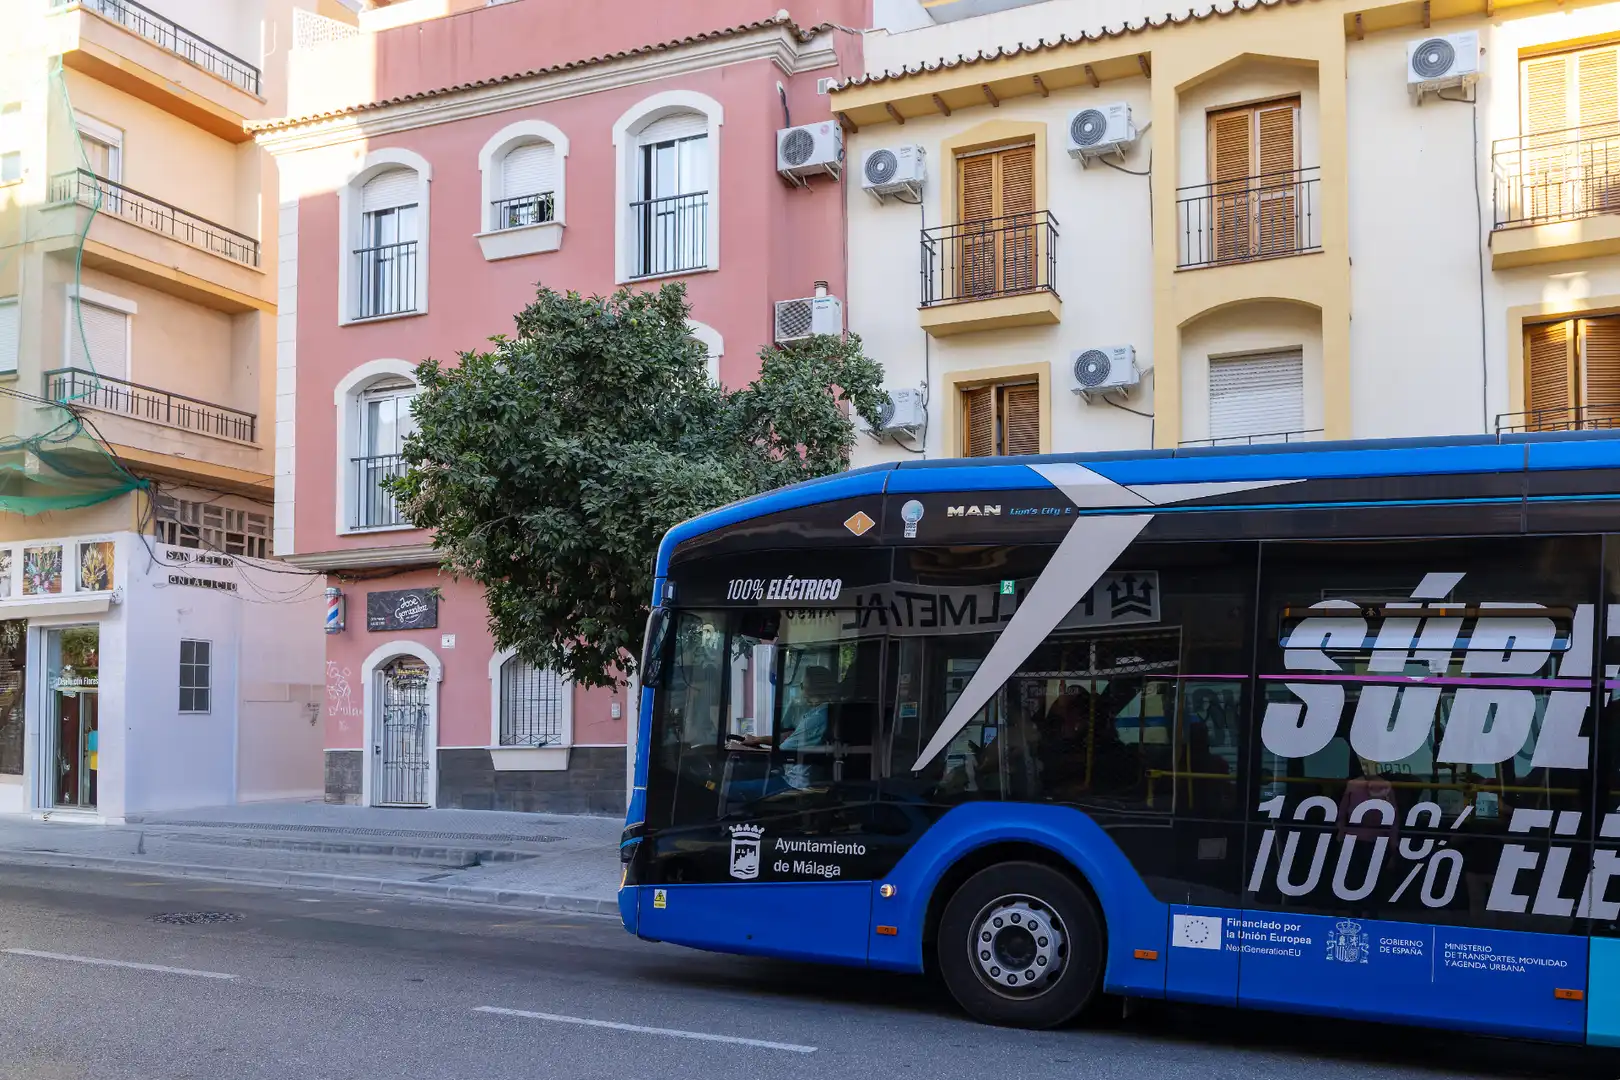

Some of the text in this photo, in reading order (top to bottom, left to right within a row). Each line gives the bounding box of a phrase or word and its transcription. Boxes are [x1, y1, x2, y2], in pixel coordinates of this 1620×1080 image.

[947, 505, 1002, 517] MAN
[1009, 507, 1038, 516] Lion's
[1041, 507, 1061, 516] City
[166, 550, 190, 562] SAN
[726, 574, 843, 601] 100% ELÉCTRICO
[775, 837, 867, 856] Ayuntamiento
[1248, 795, 1475, 909] 100%
[773, 859, 841, 878] de Málaga
[1226, 917, 1302, 932] Financiado por
[1226, 929, 1312, 945] la Unión Europea
[1379, 937, 1424, 948] GOBIERNO
[1225, 943, 1302, 957] NextGenerationEU
[1379, 945, 1423, 956] DE ESPAÑA
[1444, 942, 1493, 953] MINISTERIO
[1444, 951, 1568, 968] DE TRANSPORTES, MOVILIDAD
[1444, 959, 1526, 973] Y AGENDA URBANA
